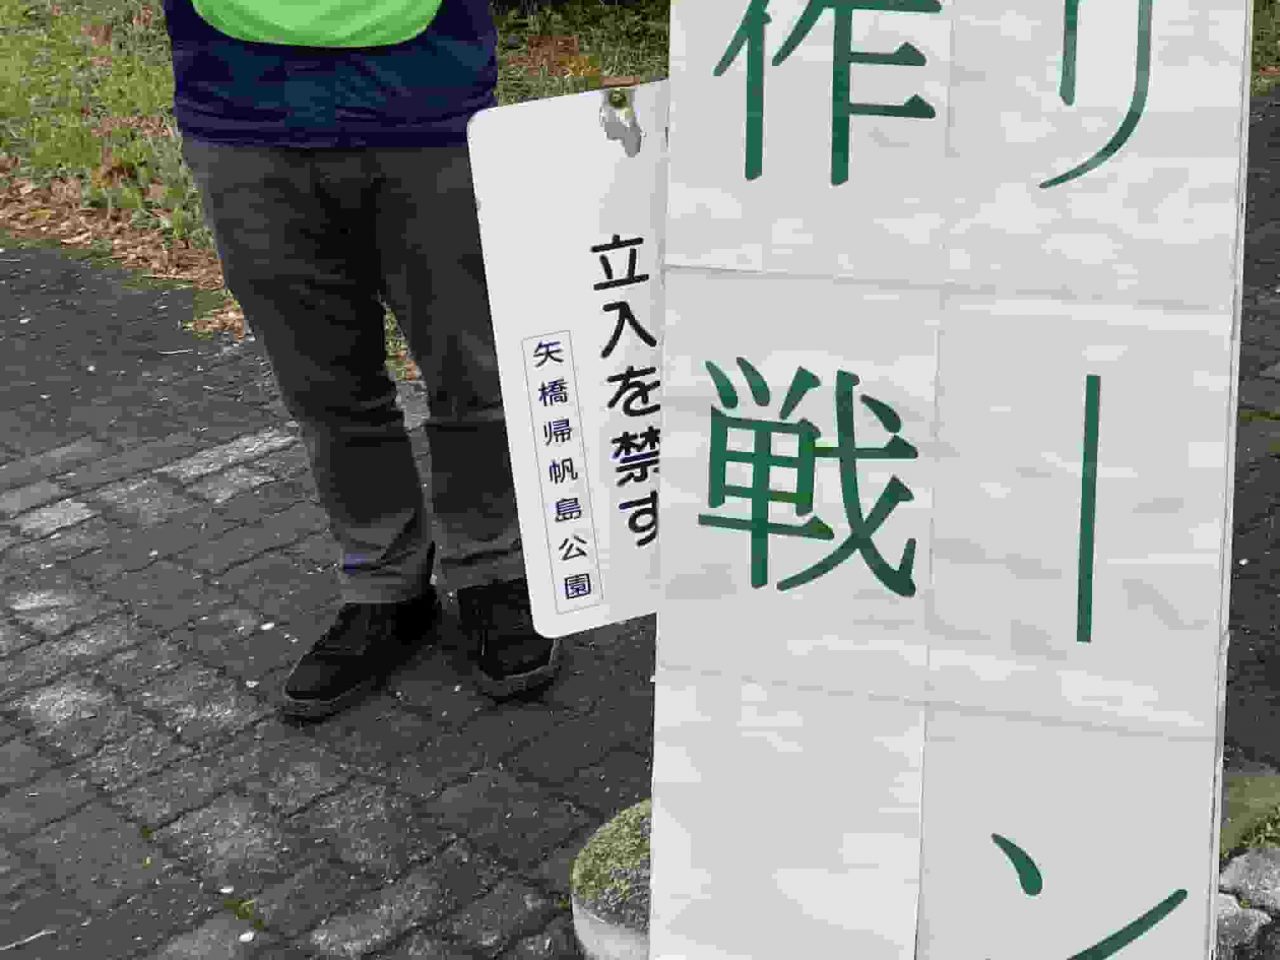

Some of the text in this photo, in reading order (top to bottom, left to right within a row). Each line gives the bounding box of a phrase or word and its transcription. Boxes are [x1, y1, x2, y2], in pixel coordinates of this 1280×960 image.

[532, 340, 593, 600] 矢橋帰帆島公園
